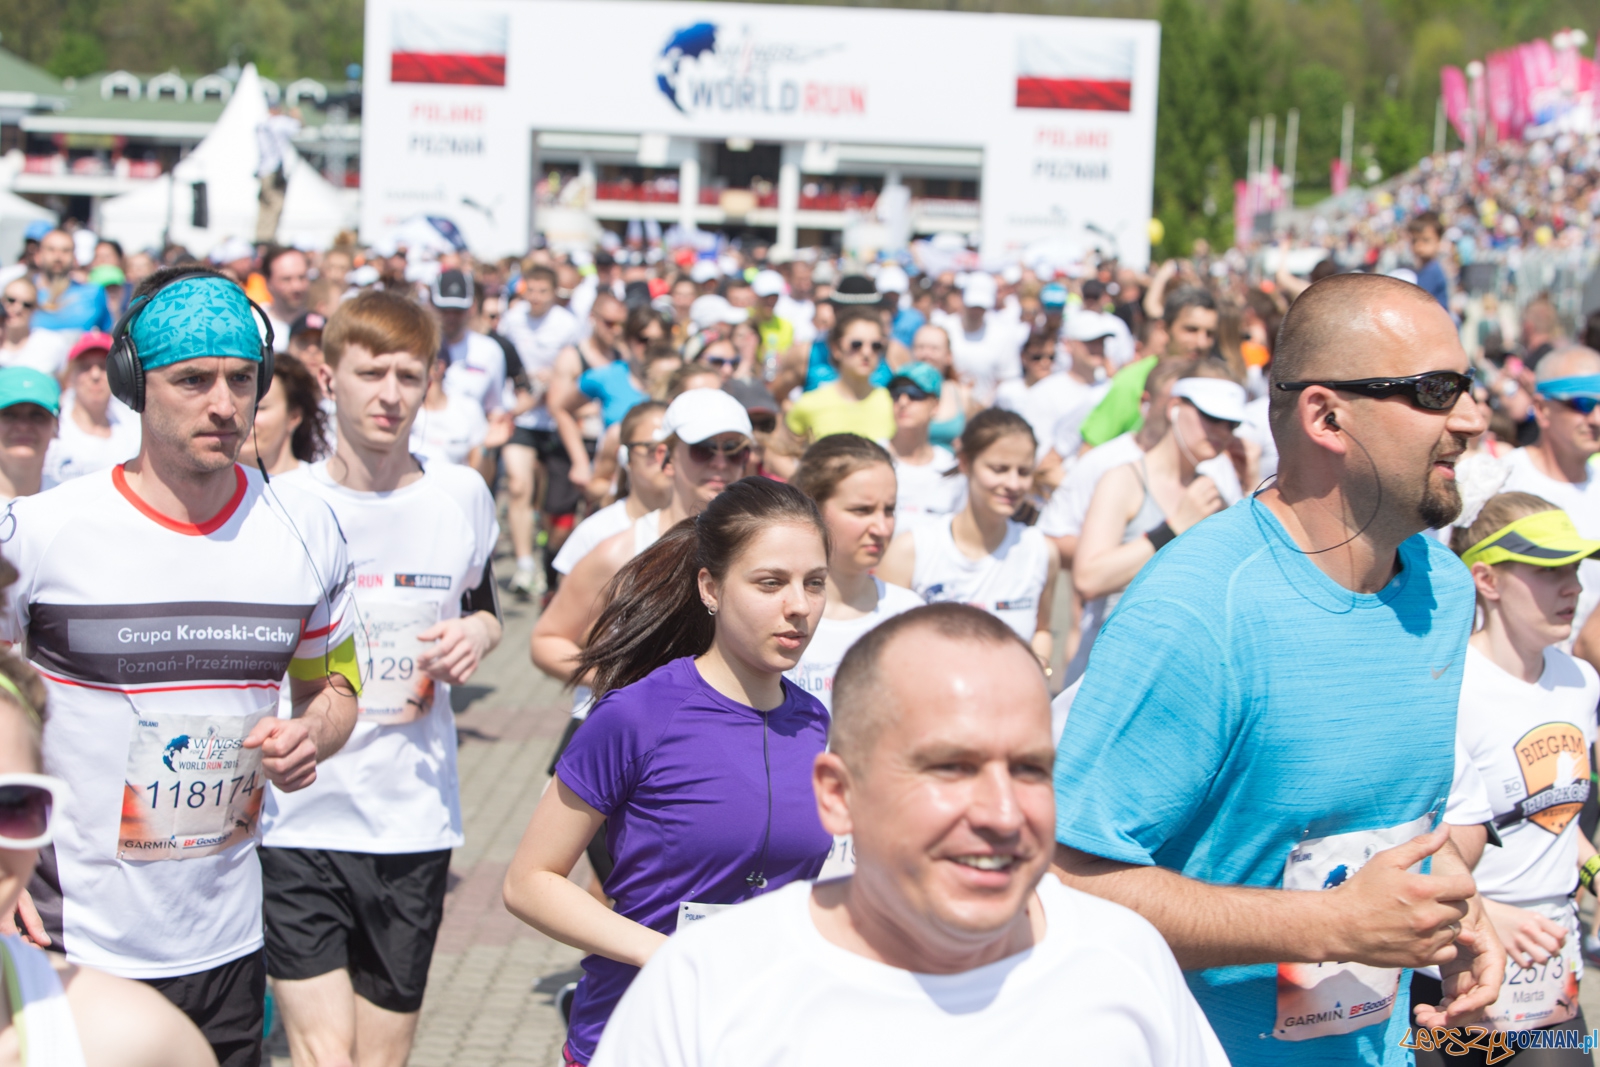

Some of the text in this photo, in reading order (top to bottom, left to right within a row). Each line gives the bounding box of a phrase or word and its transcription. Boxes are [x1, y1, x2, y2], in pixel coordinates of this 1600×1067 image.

[357, 575, 383, 588] RUN
[414, 574, 450, 588] SATURN
[117, 624, 294, 646] Grupa Krotoski-Cichy
[138, 720, 159, 728] POLAND
[193, 736, 243, 749] WINGS
[198, 749, 228, 760] LIFE
[1520, 734, 1584, 767] BIEGAM
[146, 770, 256, 810] 118174
[1503, 780, 1522, 795] BO
[124, 840, 177, 850] GARMIN
[1501, 954, 1564, 986] 2573
[1513, 990, 1545, 1004] Marta
[1284, 1009, 1344, 1028] GARMIN
